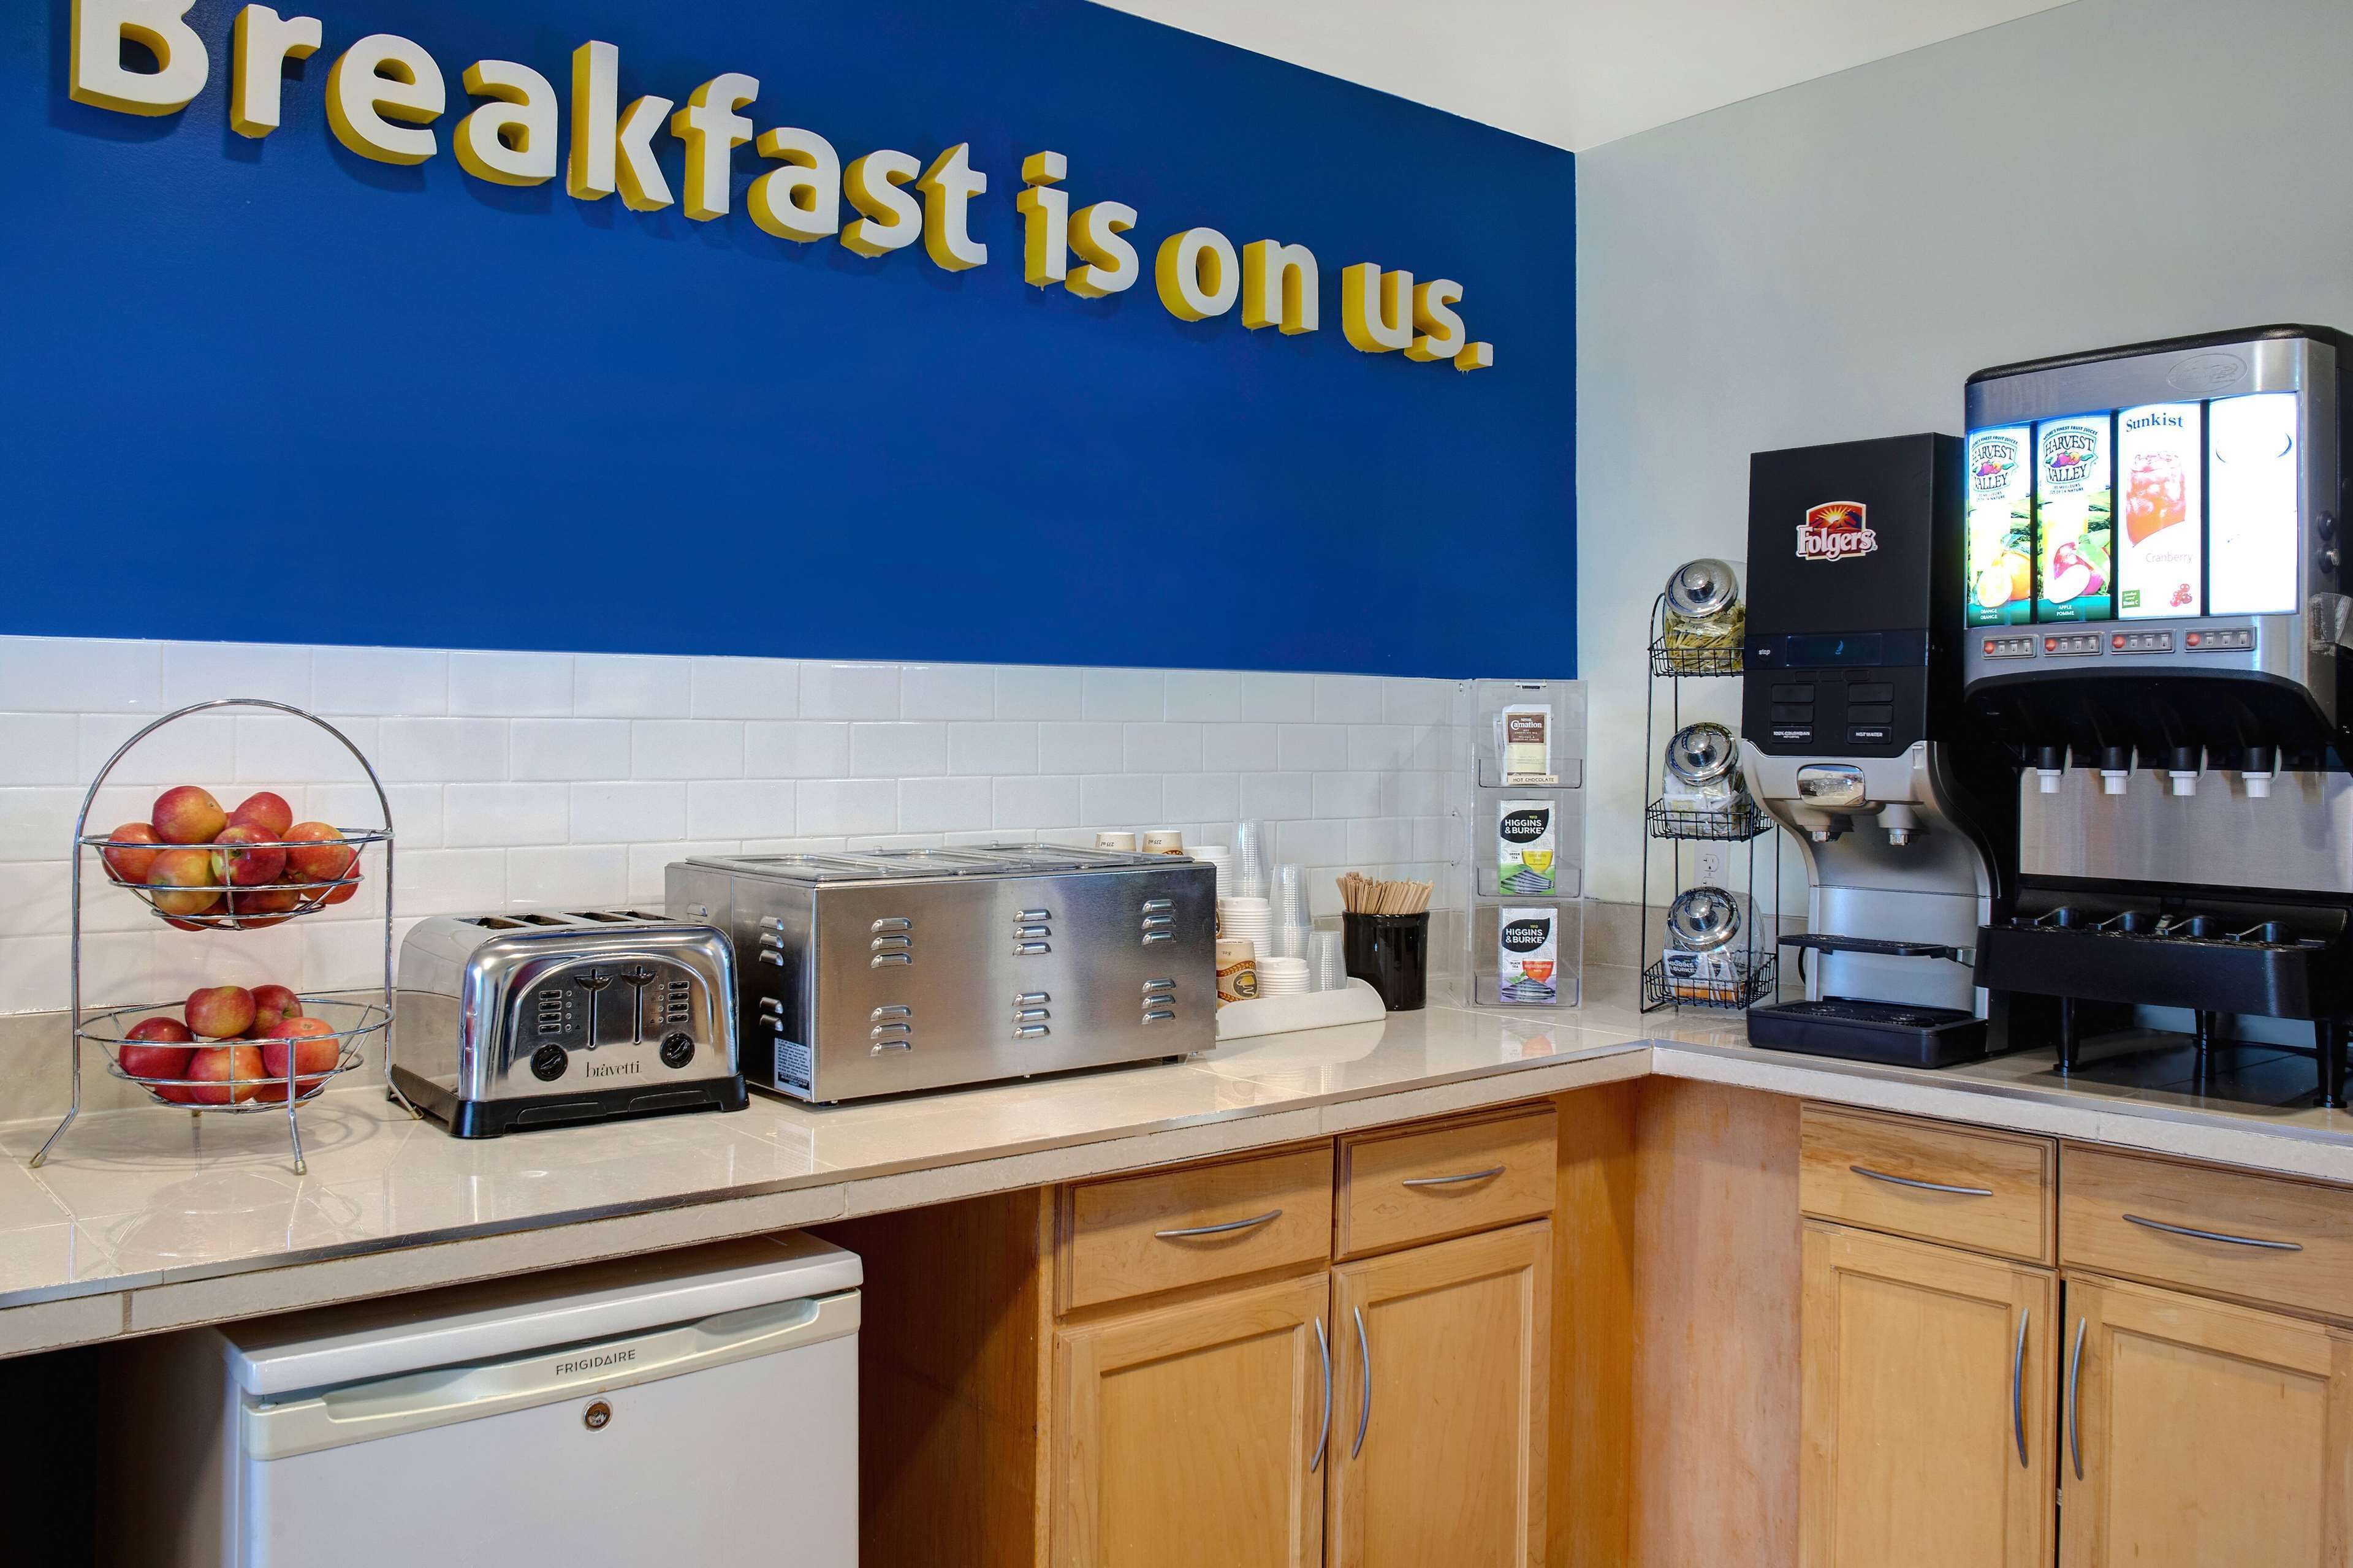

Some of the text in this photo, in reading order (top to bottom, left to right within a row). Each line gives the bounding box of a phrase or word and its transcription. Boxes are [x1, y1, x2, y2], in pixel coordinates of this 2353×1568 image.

[69, 0, 1493, 372] Breakfast is on us.
[2083, 427, 2098, 436] JUICES
[2126, 412, 2184, 432] Sunkist
[2045, 435, 2094, 456] HARVEST
[2048, 464, 2087, 482] VALLEY
[1797, 525, 1876, 559] Folgers
[2145, 551, 2192, 563] Cranberry
[556, 1349, 636, 1376] FRIGIDAIRE
